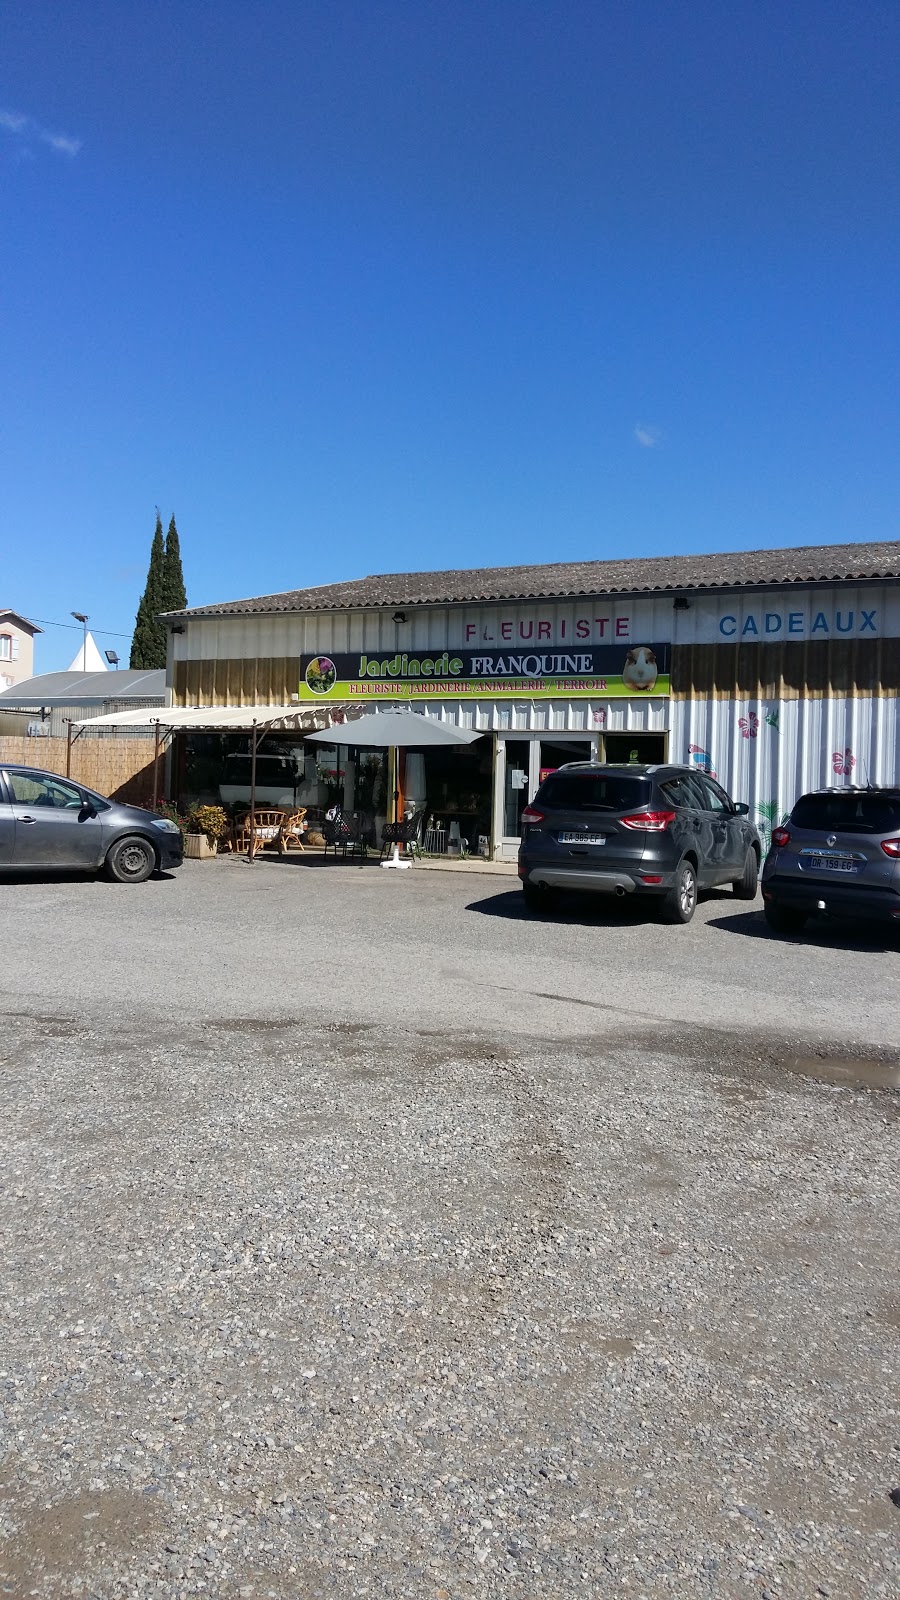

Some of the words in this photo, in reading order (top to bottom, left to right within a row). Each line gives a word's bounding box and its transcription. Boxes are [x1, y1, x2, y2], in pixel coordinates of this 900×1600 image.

[719, 610, 877, 636] CADEAUX
[358, 652, 463, 677] Jardinerie
[470, 654, 594, 678] FRANQUINE
[349, 683, 402, 694] FLEURISTE
[408, 682, 471, 694] JARDINERIE
[474, 680, 546, 692] ANIMALERIE
[554, 679, 607, 691] TERROIR
